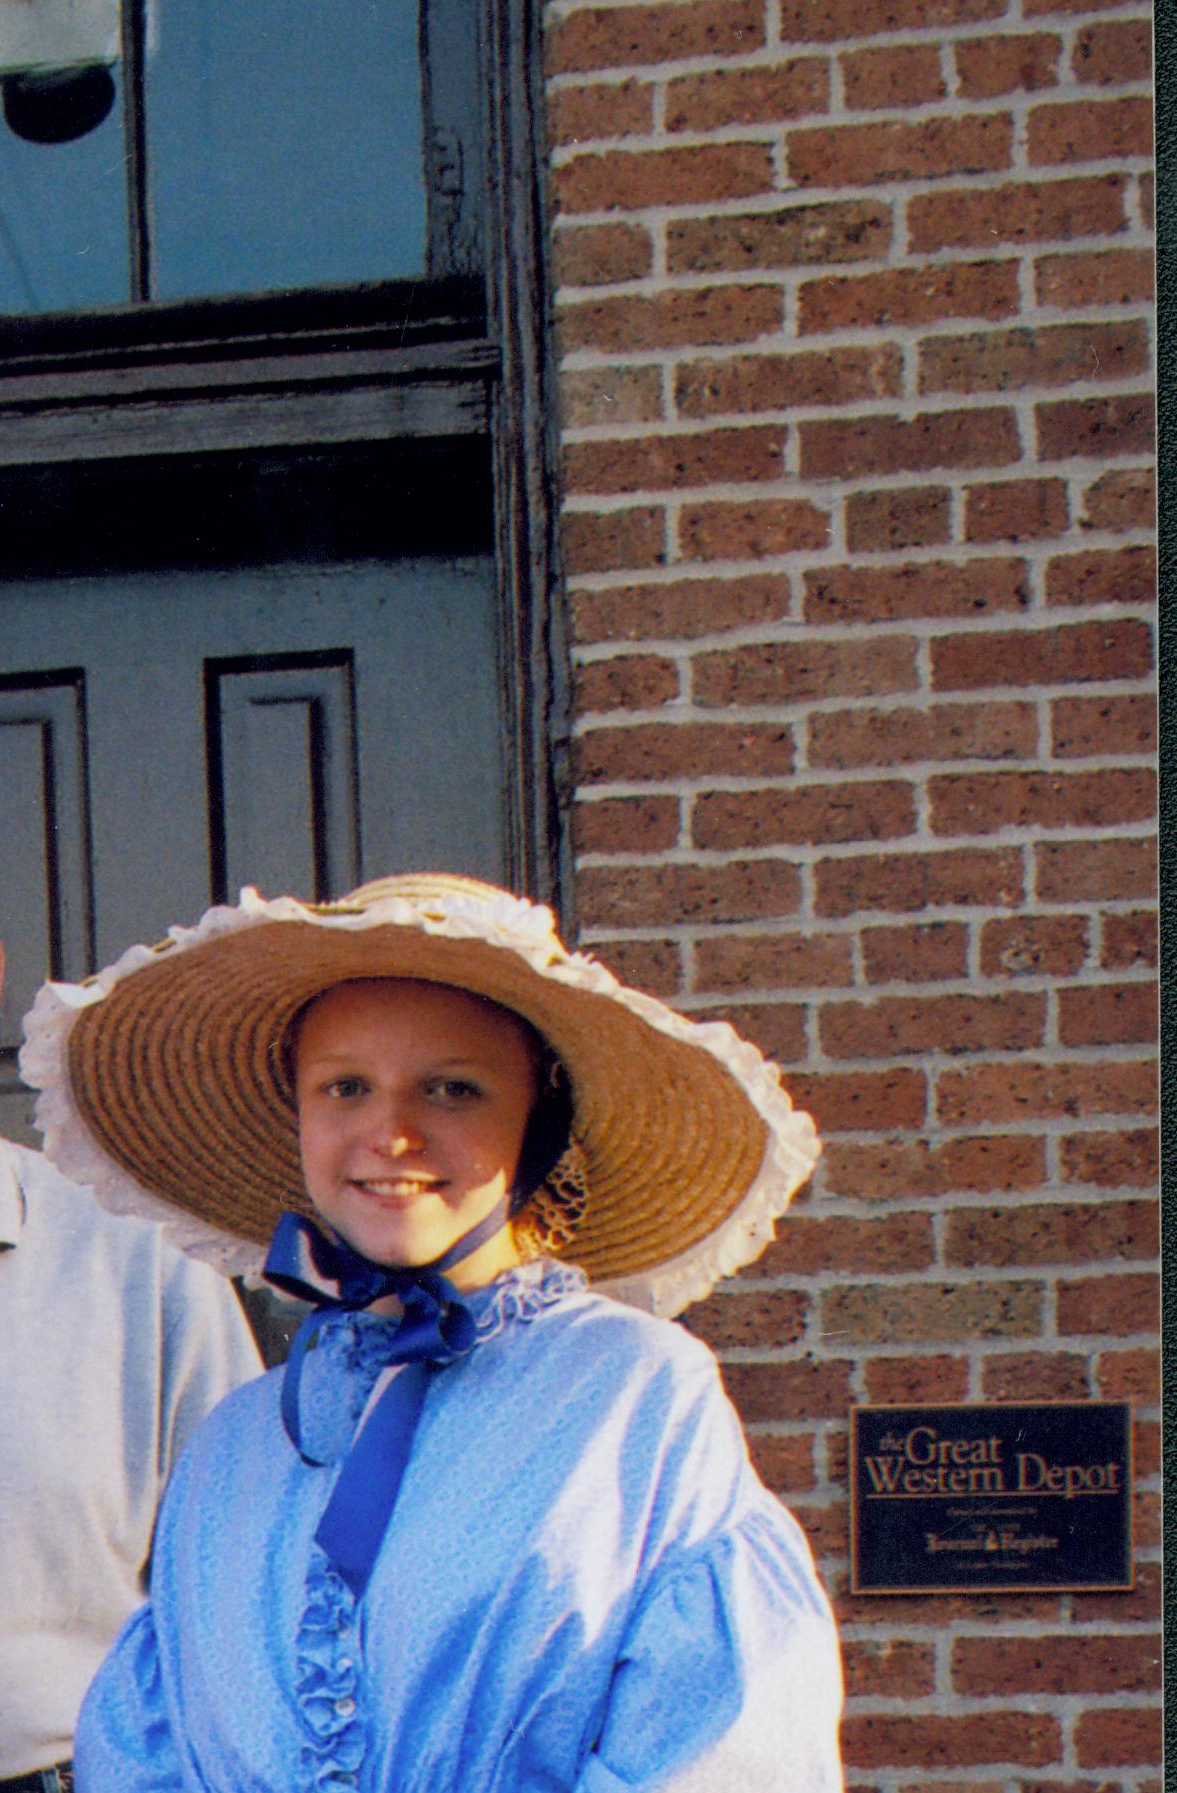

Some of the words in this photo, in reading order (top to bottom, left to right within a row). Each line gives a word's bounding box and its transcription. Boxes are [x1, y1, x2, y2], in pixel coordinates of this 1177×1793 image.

[879, 1432, 903, 1451] the
[905, 1426, 1003, 1465] Great
[865, 1455, 1005, 1494] Western
[1016, 1453, 1120, 1499] Depot
